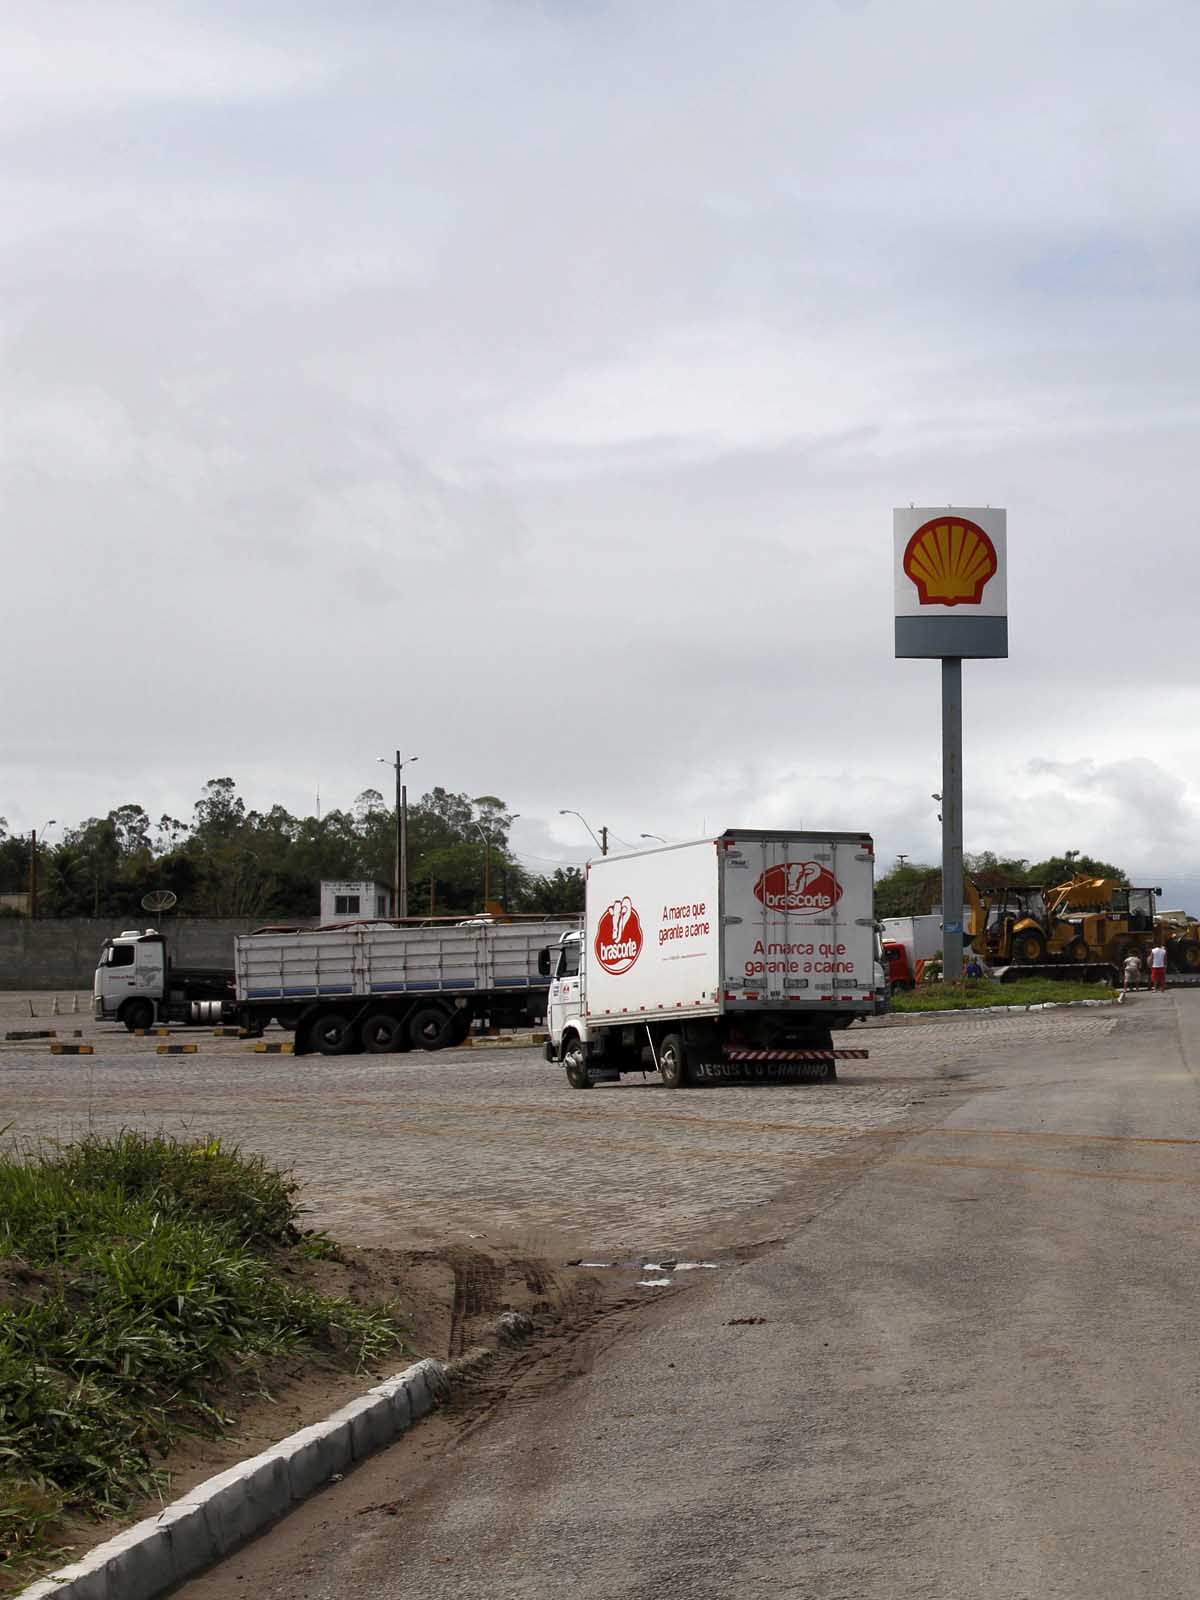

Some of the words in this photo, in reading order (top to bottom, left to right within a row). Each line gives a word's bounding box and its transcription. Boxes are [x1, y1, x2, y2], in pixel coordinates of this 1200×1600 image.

[766, 892, 832, 907] brascorte
[662, 905, 669, 921] A
[669, 907, 691, 920] marca
[692, 903, 706, 920] que
[658, 924, 684, 945] garante
[685, 925, 690, 937] a
[690, 921, 710, 936] carne
[600, 938, 637, 961] brascorte
[753, 940, 766, 955] A
[768, 943, 814, 956] marca
[819, 943, 846, 959] que
[744, 959, 799, 977] garante
[803, 961, 813, 974] a
[815, 961, 855, 974] carne
[696, 1063, 740, 1077] JESUS
